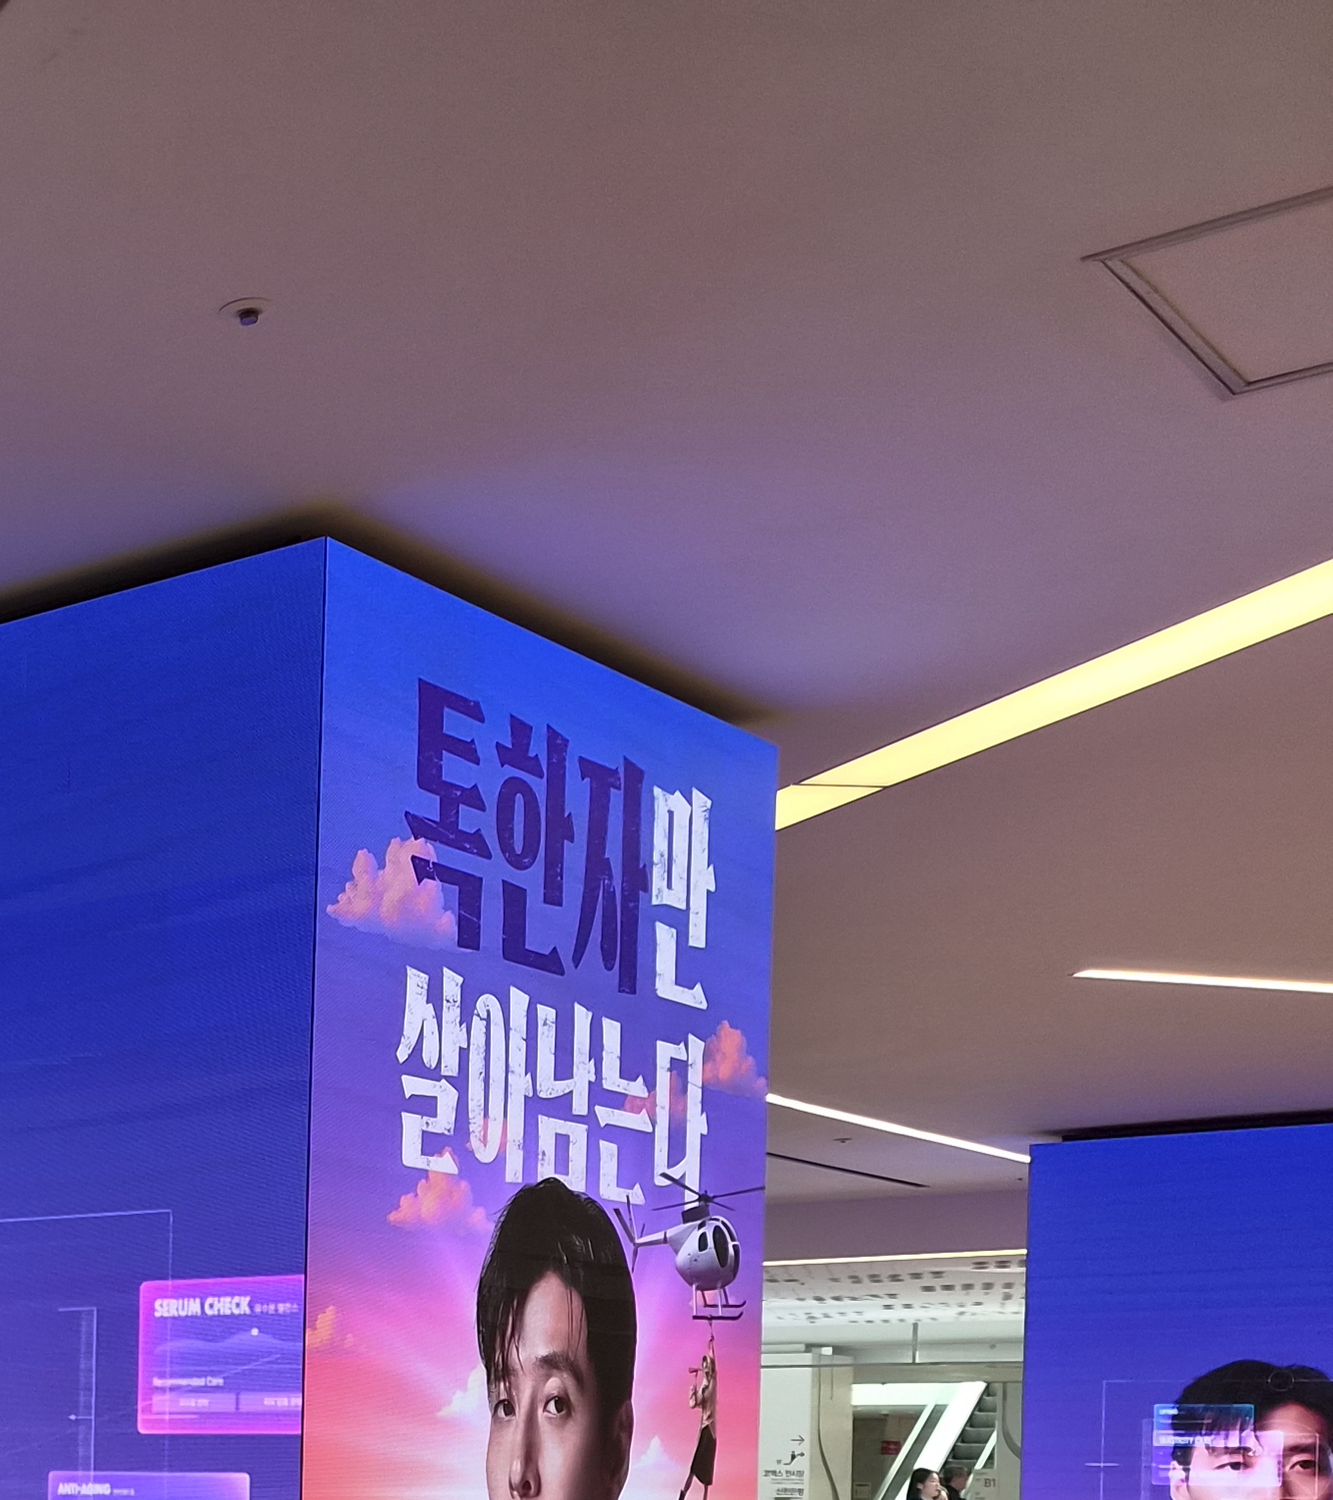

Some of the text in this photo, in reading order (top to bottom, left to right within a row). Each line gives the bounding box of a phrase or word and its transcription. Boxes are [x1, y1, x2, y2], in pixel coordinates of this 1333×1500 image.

[404, 677, 716, 1010] 톡한자만
[396, 965, 709, 1209] 살아남는다
[154, 1298, 201, 1317] SERUM
[204, 1296, 251, 1315] CHECK
[57, 1482, 112, 1496] ANTI-AGING
[984, 1478, 997, 1488] B1
